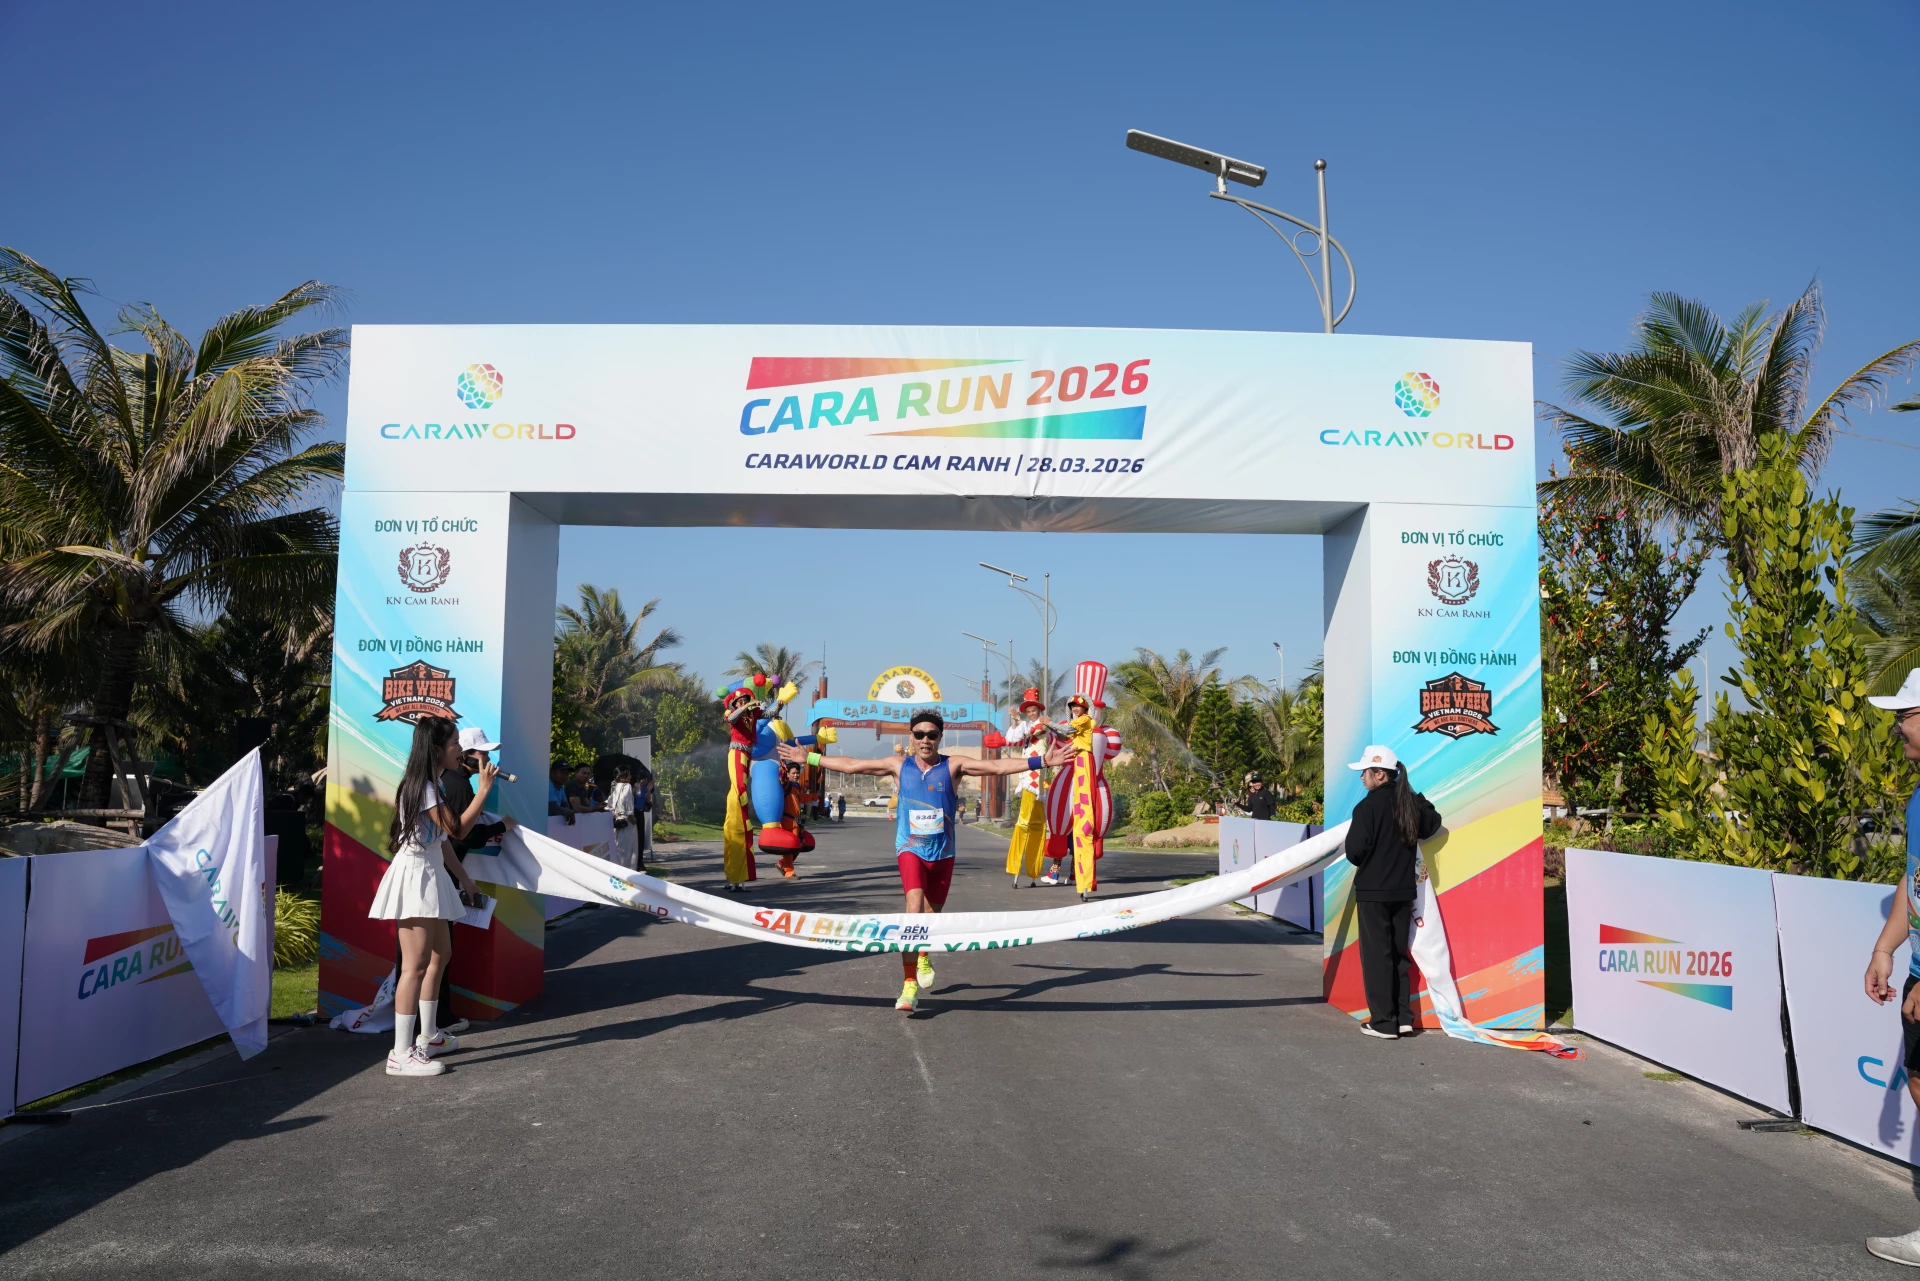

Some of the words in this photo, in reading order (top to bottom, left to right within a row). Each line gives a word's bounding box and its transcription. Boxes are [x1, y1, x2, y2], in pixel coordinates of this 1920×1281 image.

[740, 387, 879, 436] CARA
[896, 373, 1012, 419] RUN
[1026, 359, 1150, 406] 2026
[380, 423, 576, 440] CARAWORLD
[1320, 429, 1514, 450] CARAWORLD
[744, 453, 888, 470] CARAWORLD
[892, 454, 940, 471] CAM
[945, 455, 1010, 472] RANH
[1026, 457, 1145, 474] 28.03.2026
[374, 519, 402, 532] ĐƠN
[406, 520, 418, 534] VỊ
[422, 516, 438, 532] TỔ
[442, 517, 478, 532] CHỨC
[1400, 531, 1428, 544] ĐƠN
[1432, 533, 1444, 547] VỊ
[1448, 529, 1464, 545] TỔ
[1468, 531, 1504, 546] CHỨC
[386, 597, 402, 605] KN
[1418, 608, 1433, 616] KN
[358, 638, 386, 652] ĐƠN
[390, 640, 402, 654] VỊ
[406, 636, 442, 652] ĐỒNG
[446, 637, 484, 652] HÀNH
[1392, 650, 1420, 664] ĐƠN
[1424, 652, 1436, 666] VỊ
[1440, 648, 1476, 665] ĐỒNG
[1480, 650, 1517, 666] HÀNH
[384, 680, 414, 700] BIKE
[416, 680, 453, 700] WEEK
[870, 668, 940, 699] CARAWORLD
[390, 696, 424, 707] VIETNAM
[425, 697, 446, 708] 2026
[842, 704, 878, 718] CARA
[1422, 692, 1450, 712] BIKE
[1452, 692, 1489, 714] WEEK
[1428, 708, 1462, 718] VIETNAM
[1462, 709, 1483, 720] 2026
[1599, 950, 1640, 973] CARA
[1644, 950, 1682, 975] RUN
[1686, 951, 1732, 978] 2026
[78, 950, 142, 1000] CARA
